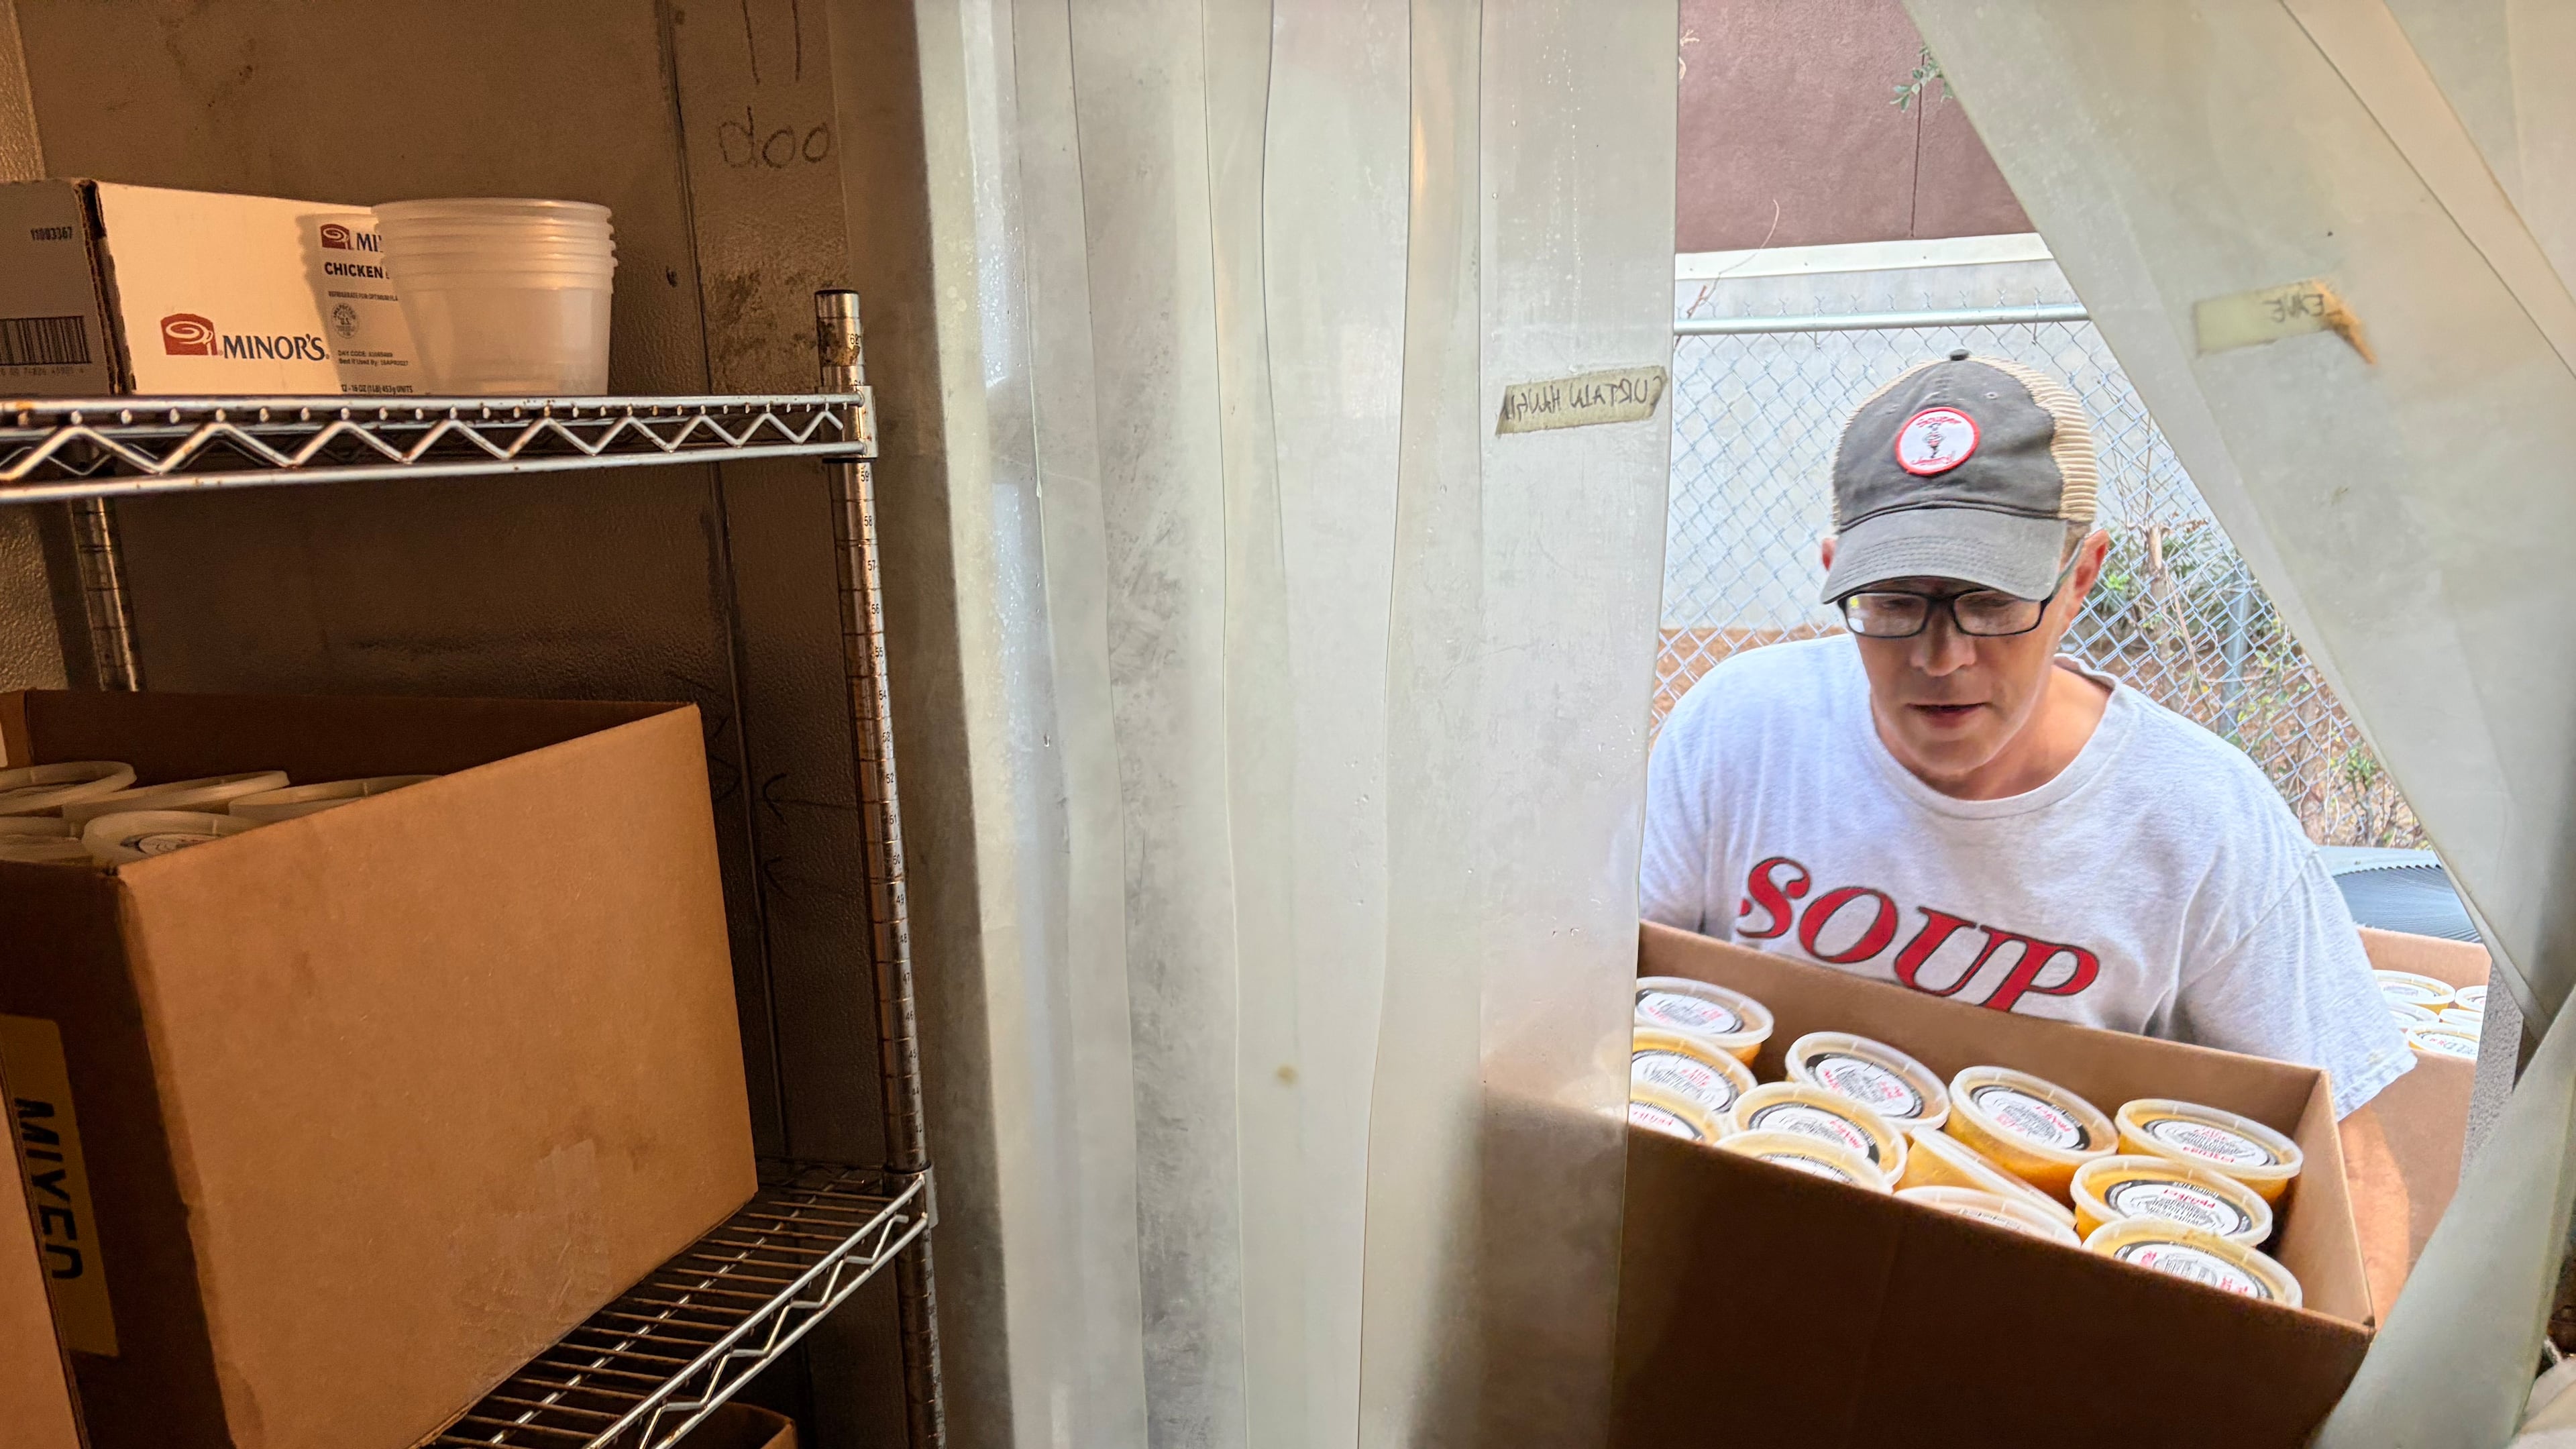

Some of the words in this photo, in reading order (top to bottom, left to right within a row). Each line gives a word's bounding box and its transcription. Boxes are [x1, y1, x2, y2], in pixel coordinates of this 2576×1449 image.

[357, 233, 384, 252] MI
[324, 262, 383, 279] CHICKEN
[223, 333, 325, 361] MINOR'S
[861, 471, 870, 482] 59
[864, 516, 873, 527] 58
[867, 559, 876, 570] 57
[871, 604, 880, 614] 56
[875, 647, 883, 657] 55
[879, 690, 887, 700] 54
[882, 731, 891, 742] 53
[886, 773, 894, 784] 52
[890, 814, 897, 824] 51
[893, 855, 901, 865] 50
[896, 894, 904, 905] 49
[1736, 855, 2100, 1013] SOUP
